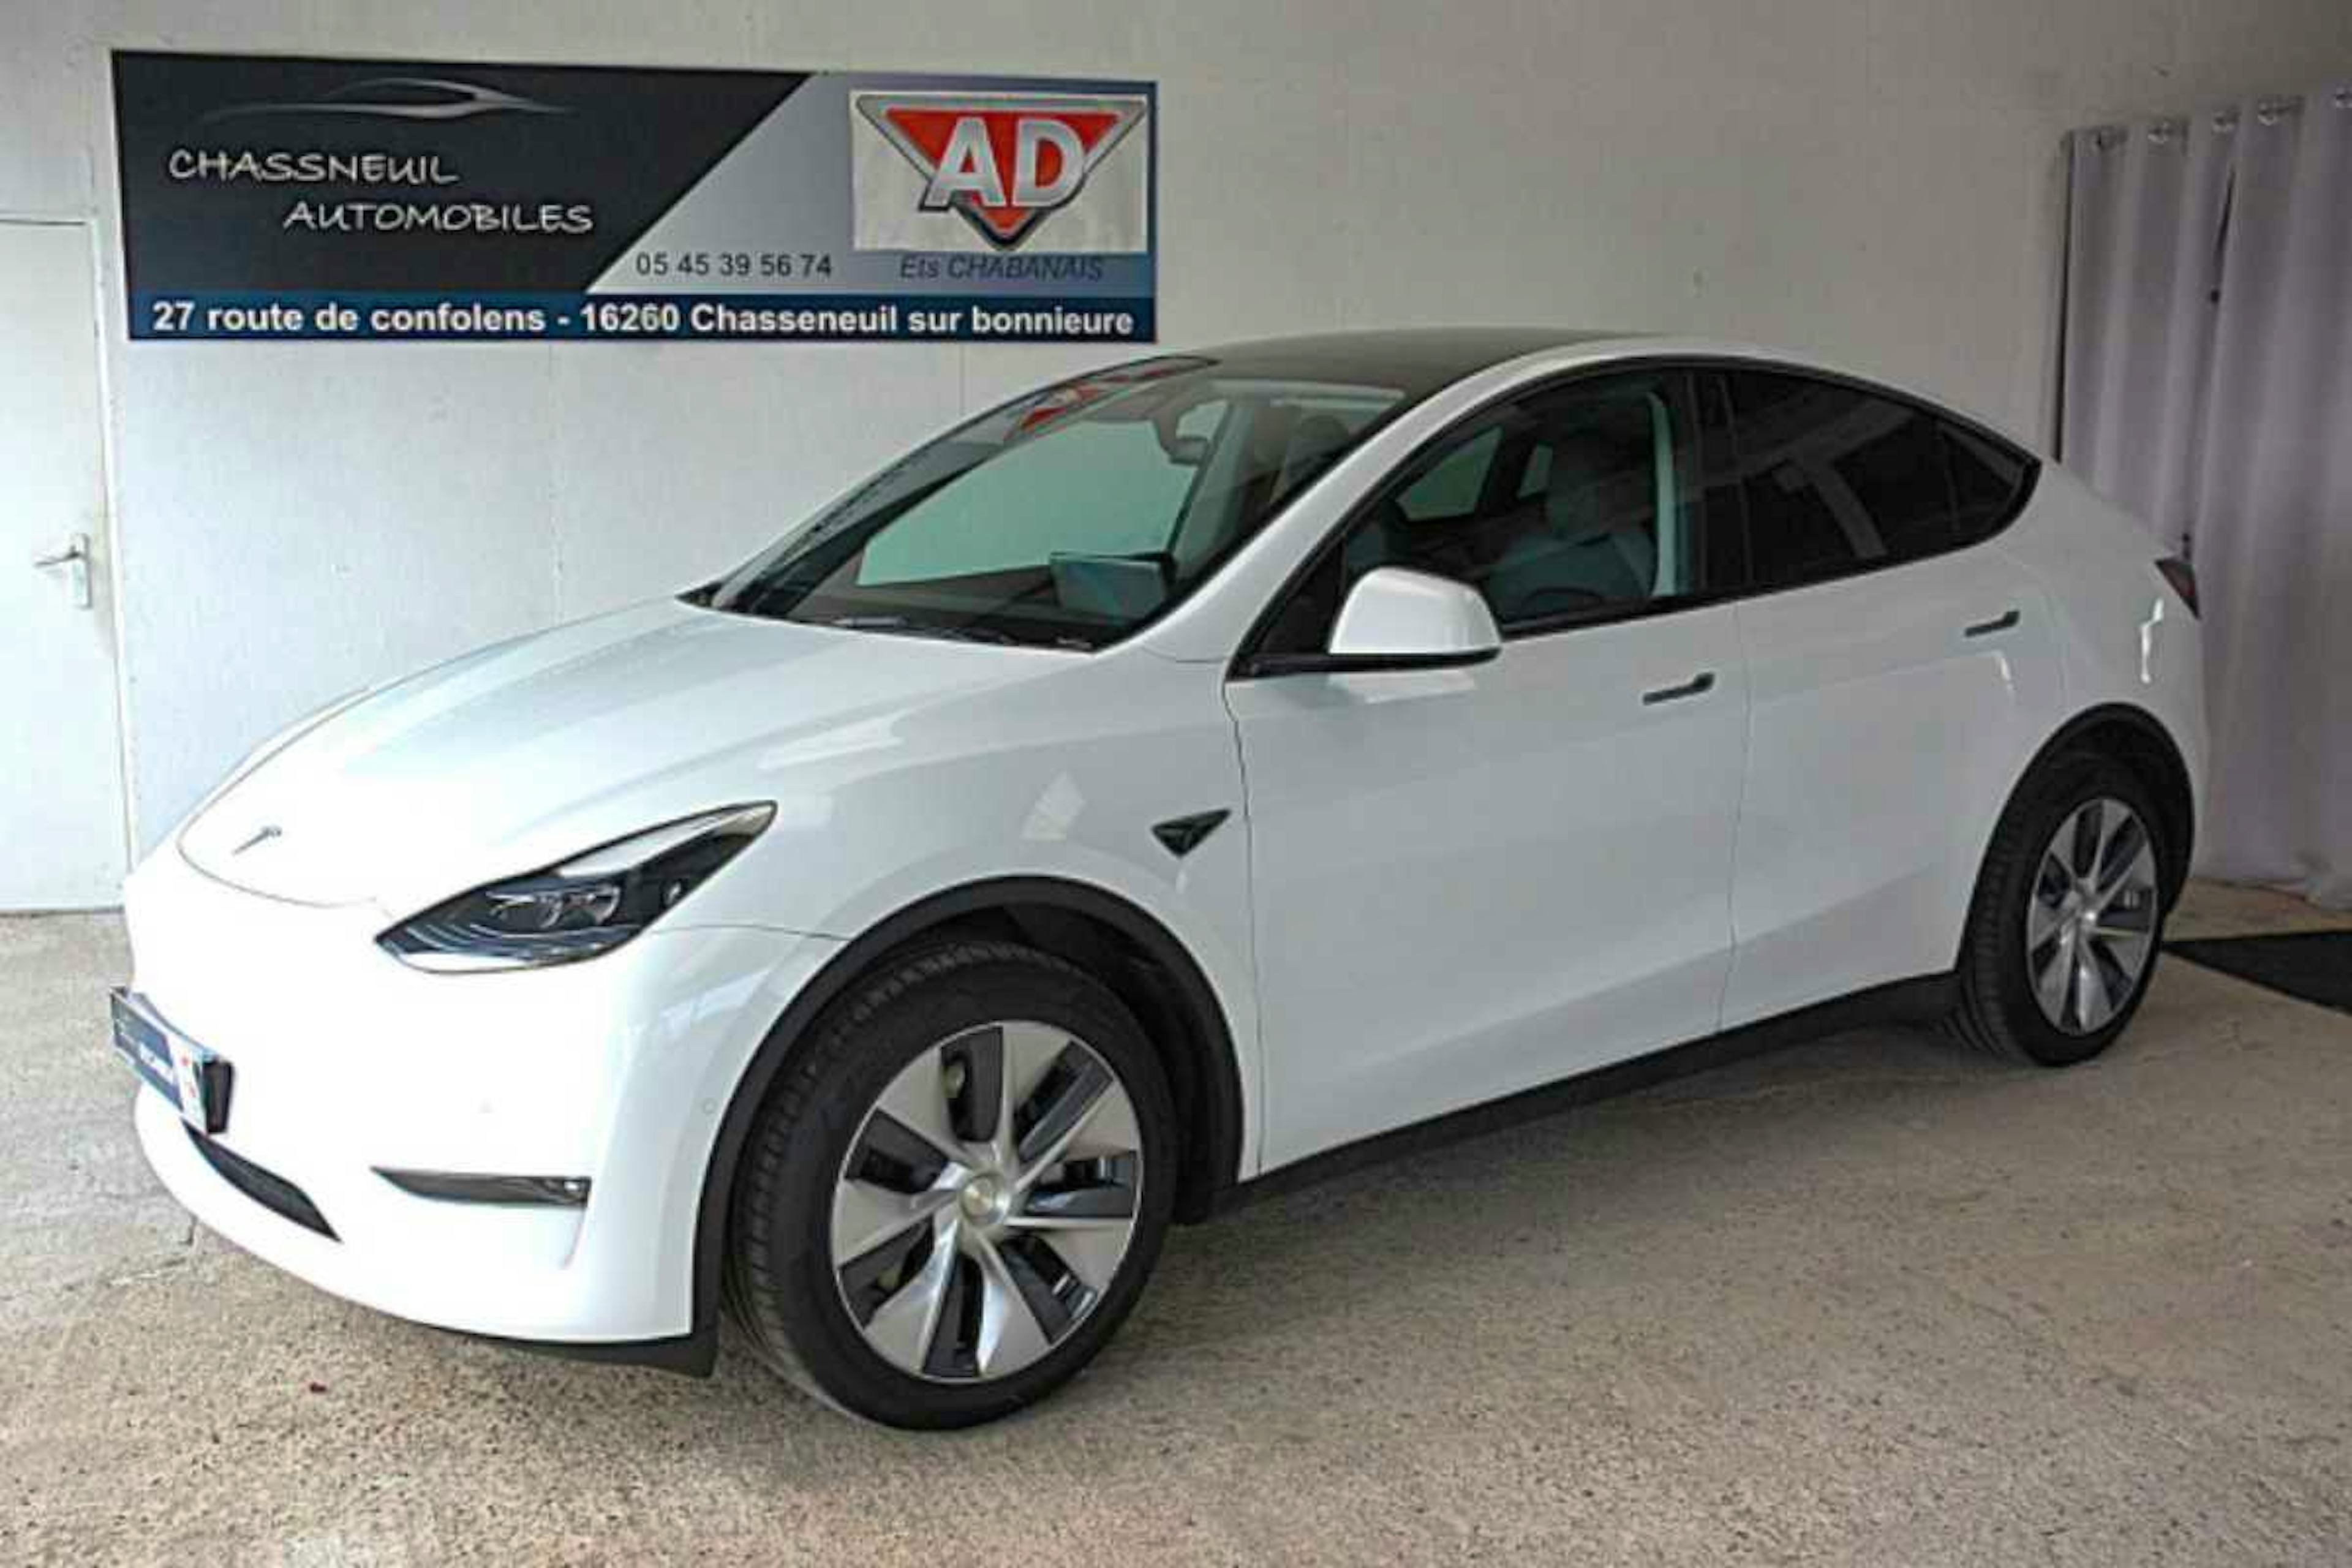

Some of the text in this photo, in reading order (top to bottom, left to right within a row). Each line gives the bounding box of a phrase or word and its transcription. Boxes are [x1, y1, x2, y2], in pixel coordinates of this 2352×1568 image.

[168, 149, 458, 184] CHASSNEUIL
[921, 116, 1087, 209] AD
[283, 201, 594, 234] AUTOMOBILES
[636, 253, 832, 277] 05 45 39 56 74
[899, 254, 1102, 281] Ets CHABANAIS
[152, 302, 195, 331] 27
[208, 304, 303, 331] route
[314, 303, 358, 331] de
[371, 303, 545, 331] confolens
[581, 304, 681, 331] 16260
[691, 304, 897, 332] Chasseneuil
[907, 311, 963, 332] sur
[972, 306, 1133, 334] bonnieure
